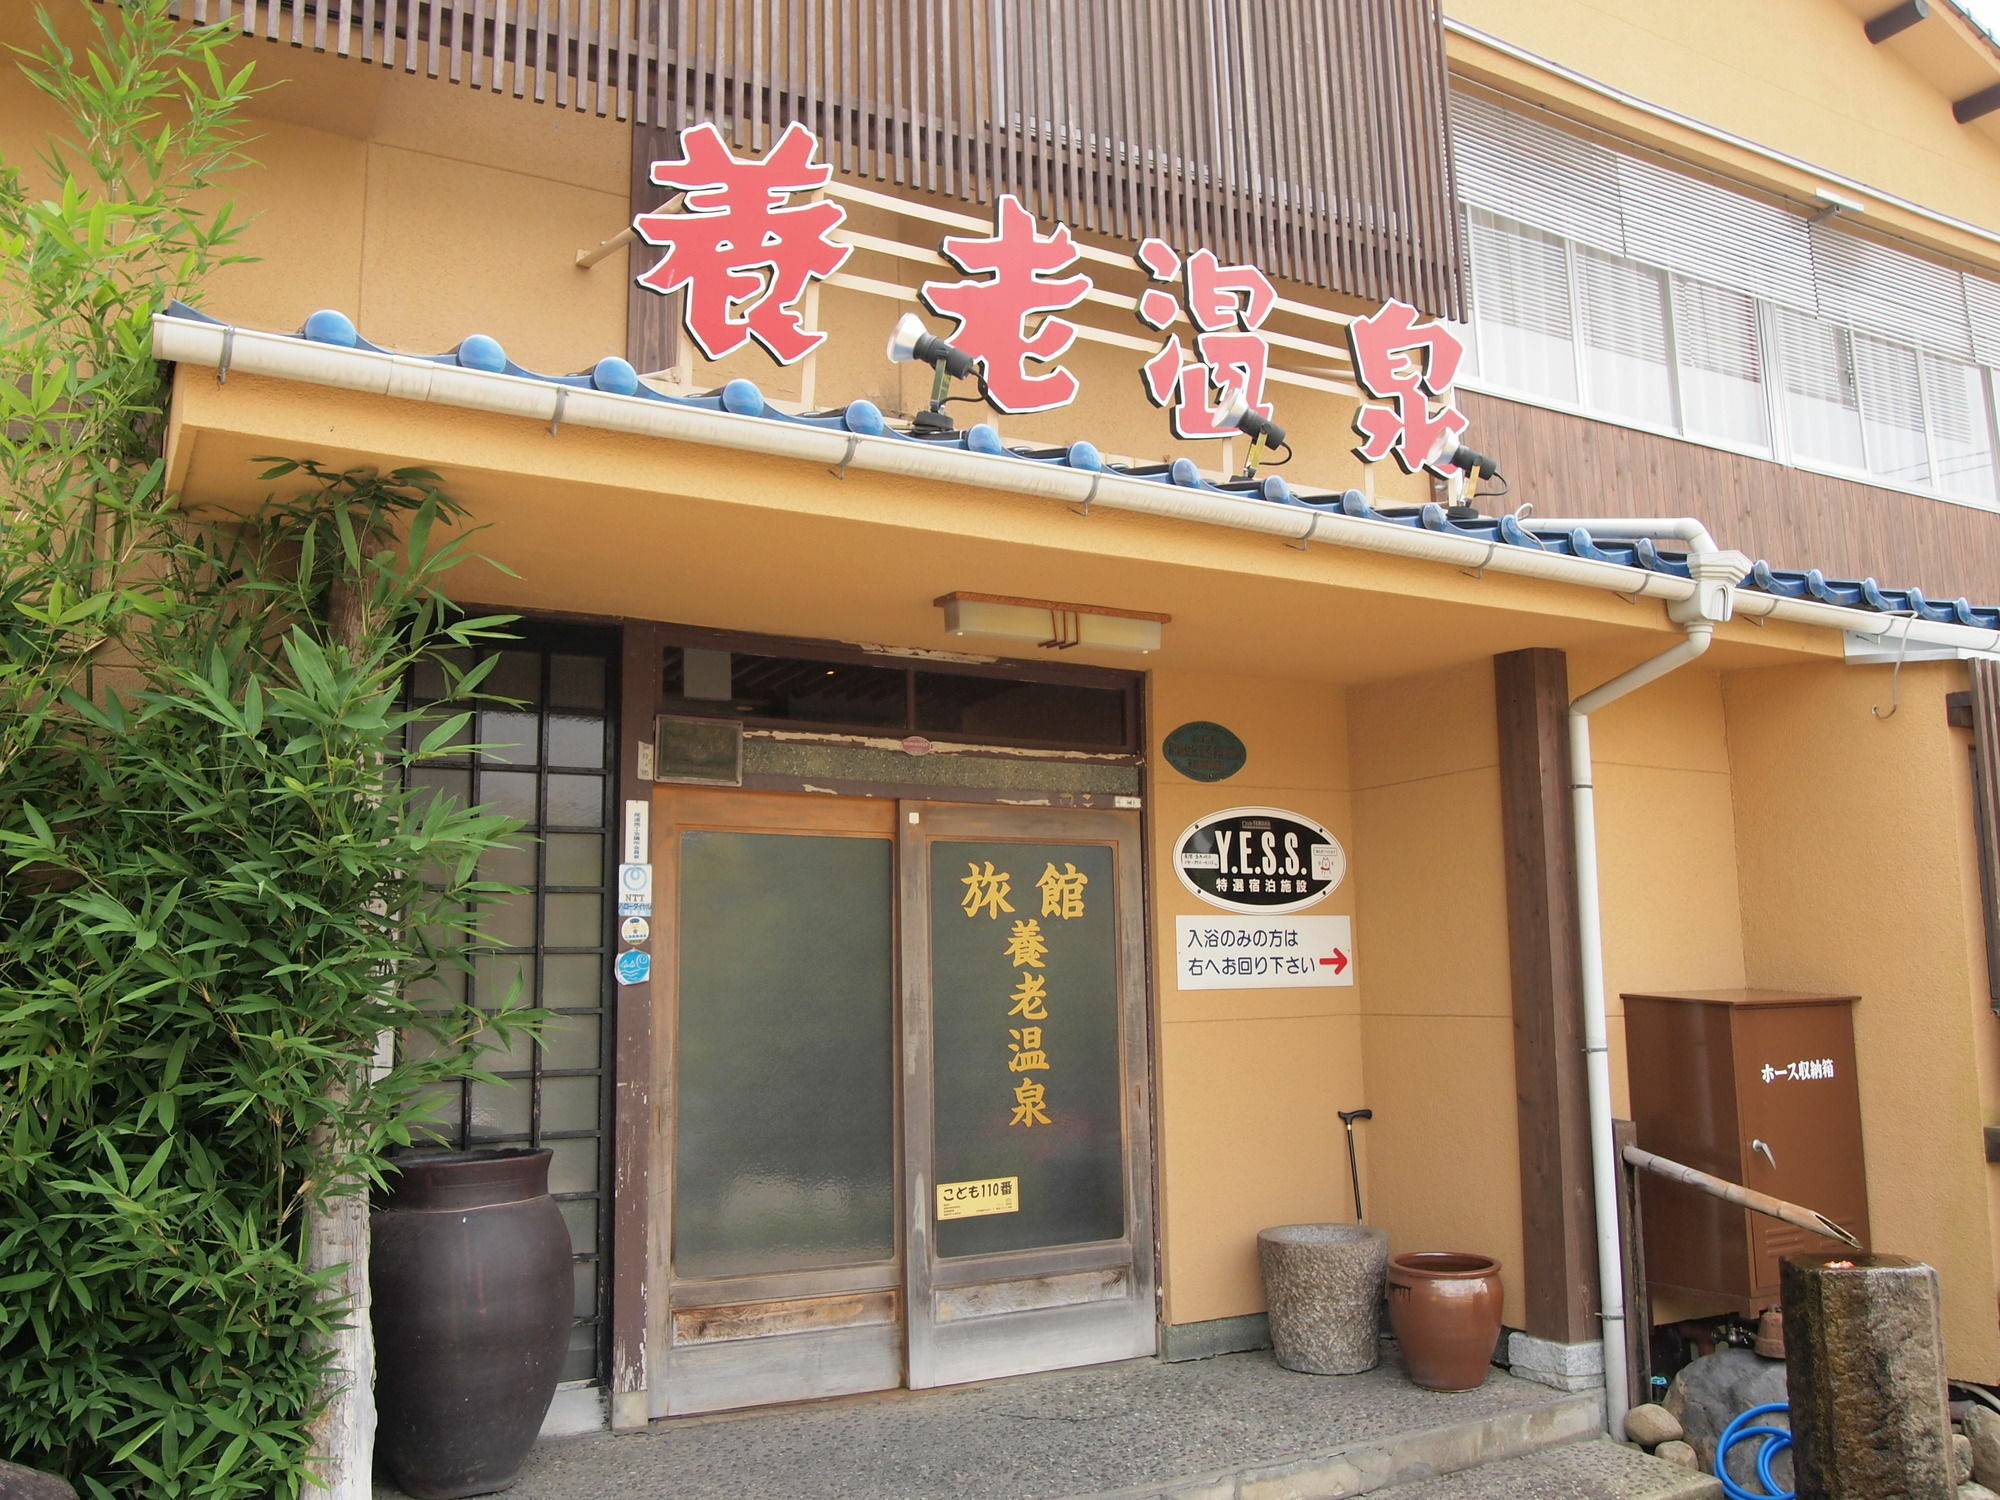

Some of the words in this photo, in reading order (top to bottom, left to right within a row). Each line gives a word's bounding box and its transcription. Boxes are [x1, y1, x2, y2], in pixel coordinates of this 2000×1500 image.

[633, 120, 1472, 476] 養老温泉
[1214, 830, 1307, 875] Y.E.S.S.
[961, 861, 1089, 920] 旅館
[1215, 878, 1307, 893] 特選宿泊施設
[625, 894, 645, 902] NTT
[1187, 929, 1298, 948] 入浴のみの方は
[1188, 956, 1315, 976] 右へお回り下さい
[1003, 919, 1052, 1128] 養老温泉
[1761, 1058, 1834, 1084] ホース収納箱
[943, 1182, 1012, 1201] こども110番
